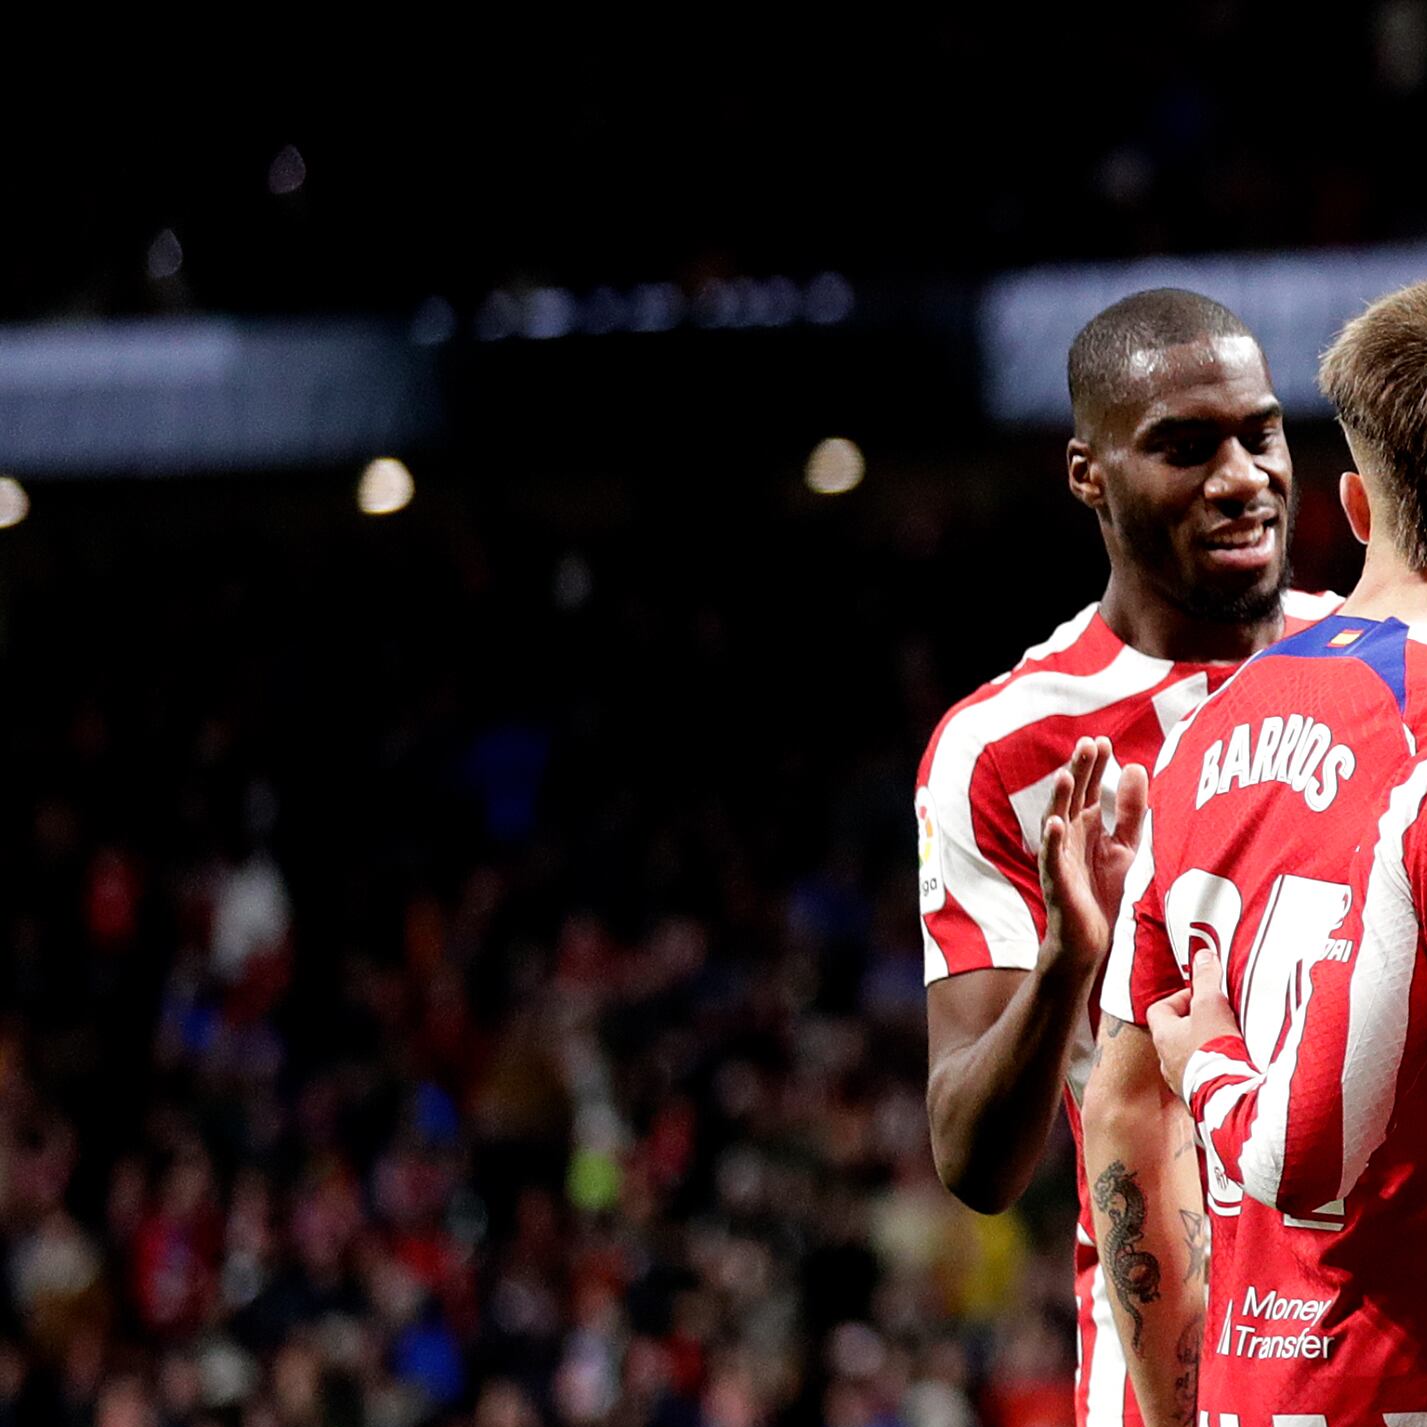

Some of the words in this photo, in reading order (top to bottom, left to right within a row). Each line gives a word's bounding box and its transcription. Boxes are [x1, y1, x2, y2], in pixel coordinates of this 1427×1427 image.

[1195, 713, 1357, 813] BARRIOS
[1241, 1285, 1333, 1328] Money
[1235, 1325, 1336, 1360] Transfer
